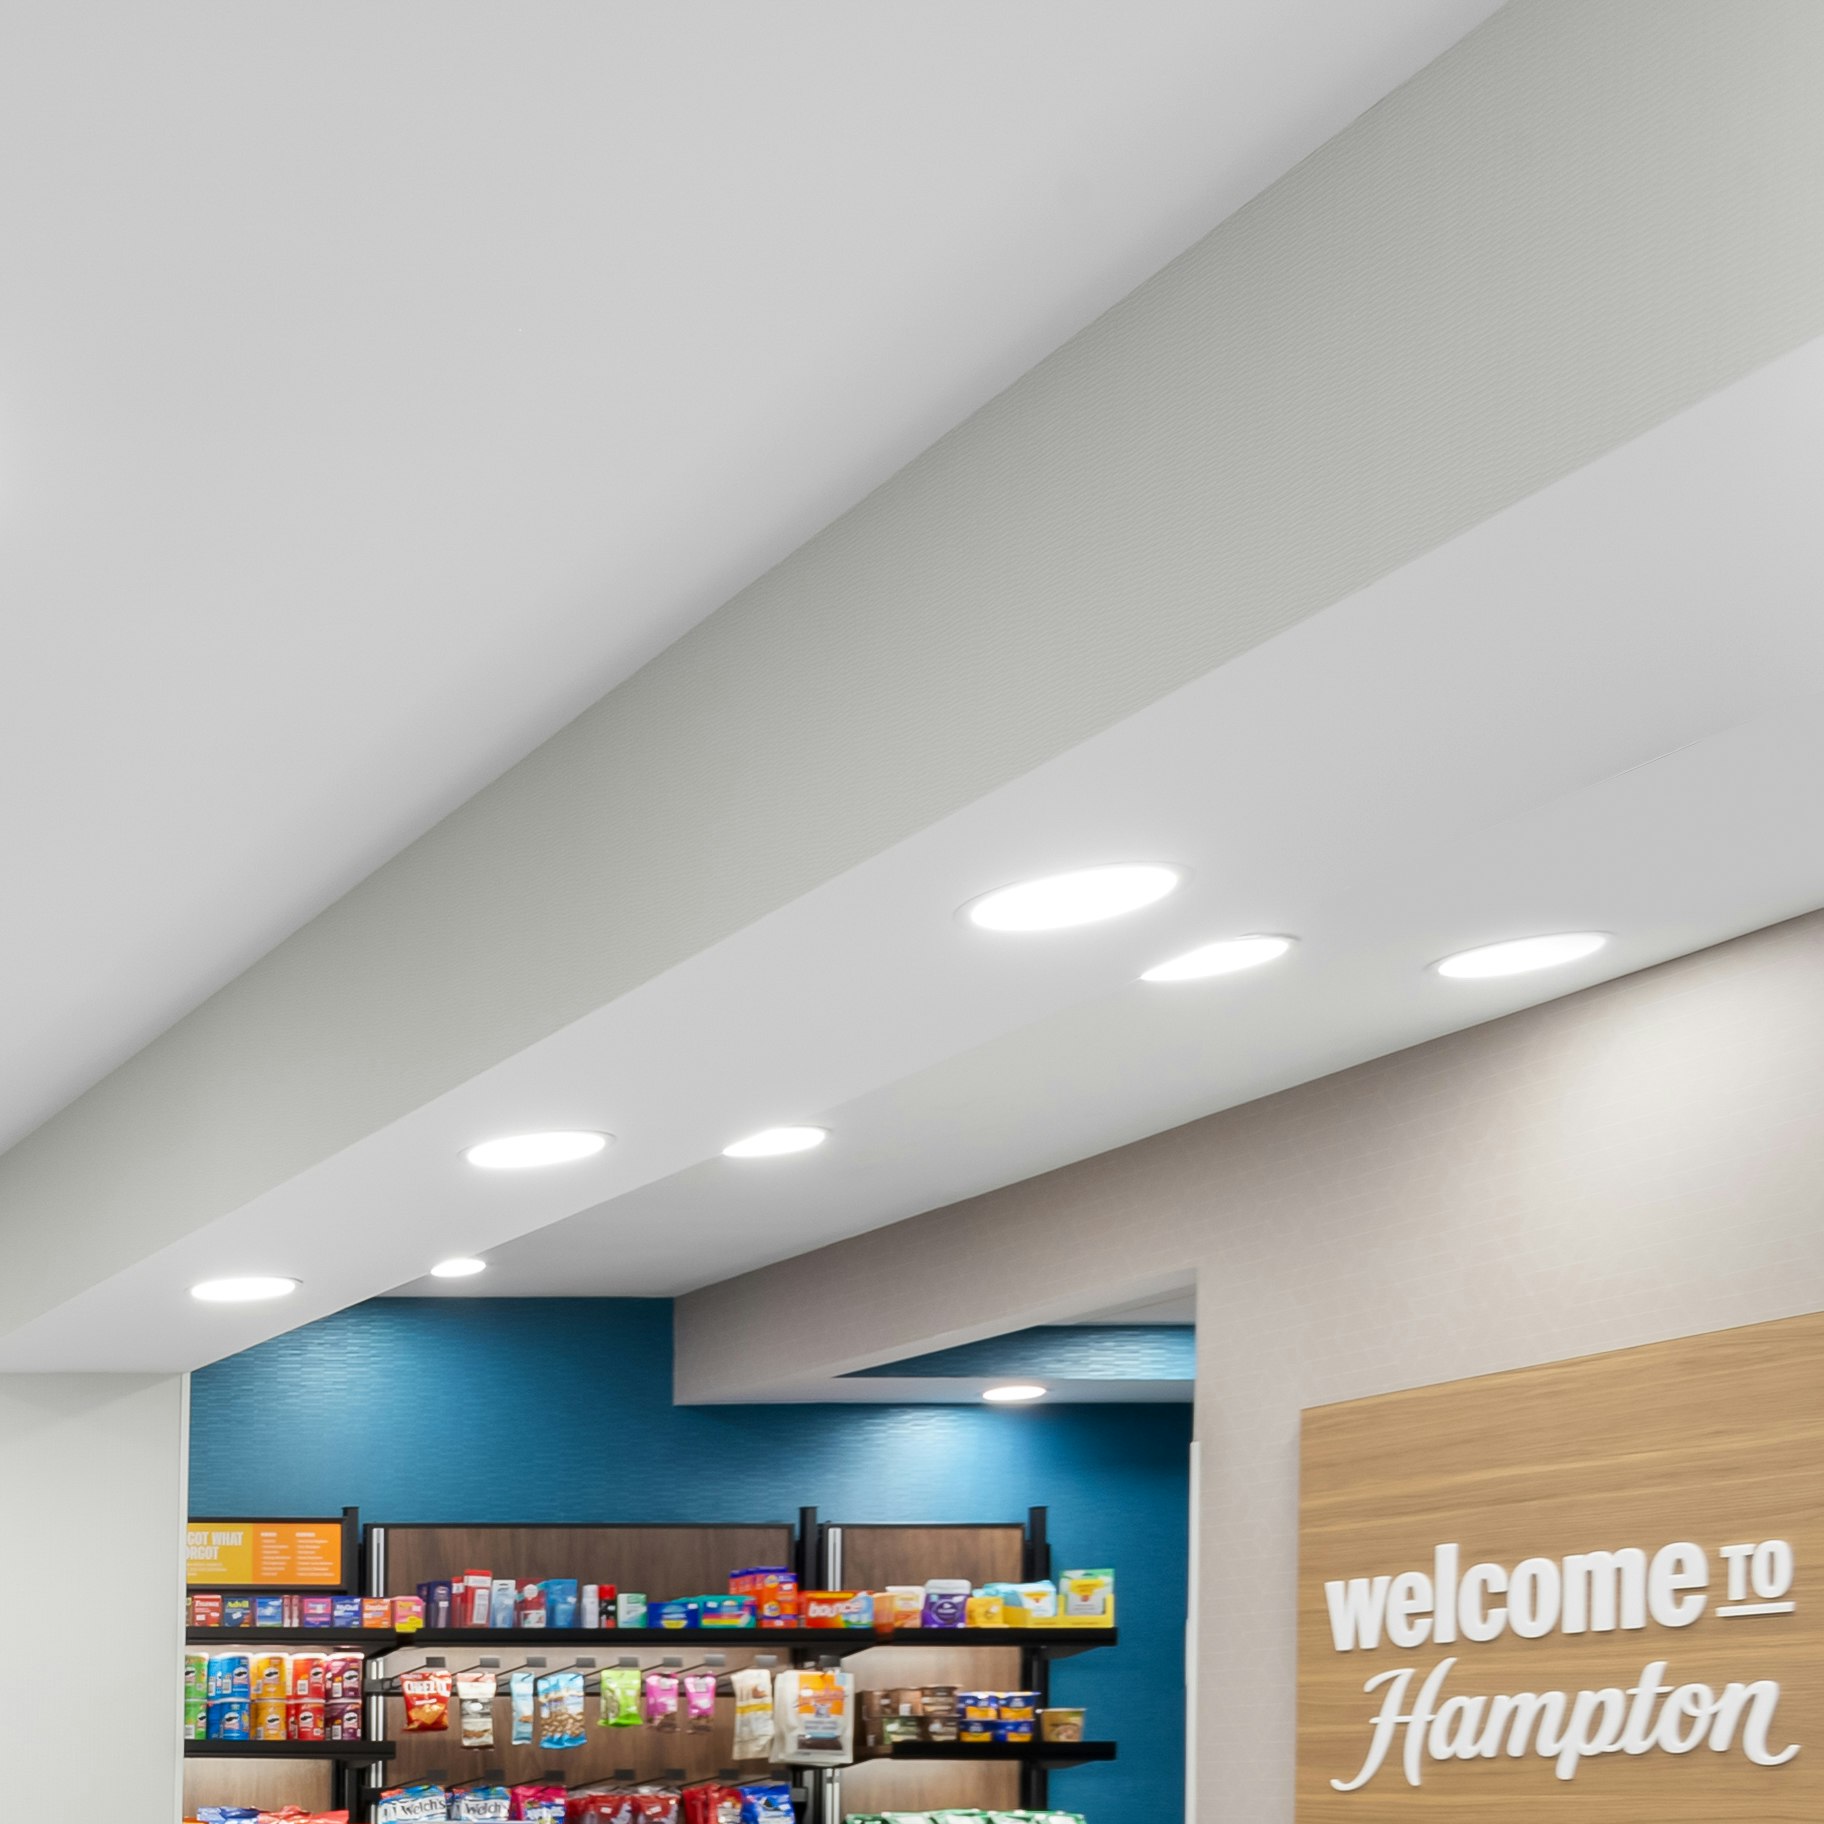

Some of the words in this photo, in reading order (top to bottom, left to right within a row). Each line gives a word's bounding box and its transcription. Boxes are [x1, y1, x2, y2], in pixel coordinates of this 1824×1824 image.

[1324, 1542, 1709, 1651] welcome
[1719, 1539, 1794, 1601] TO
[1330, 1657, 1801, 1791] Hampton
